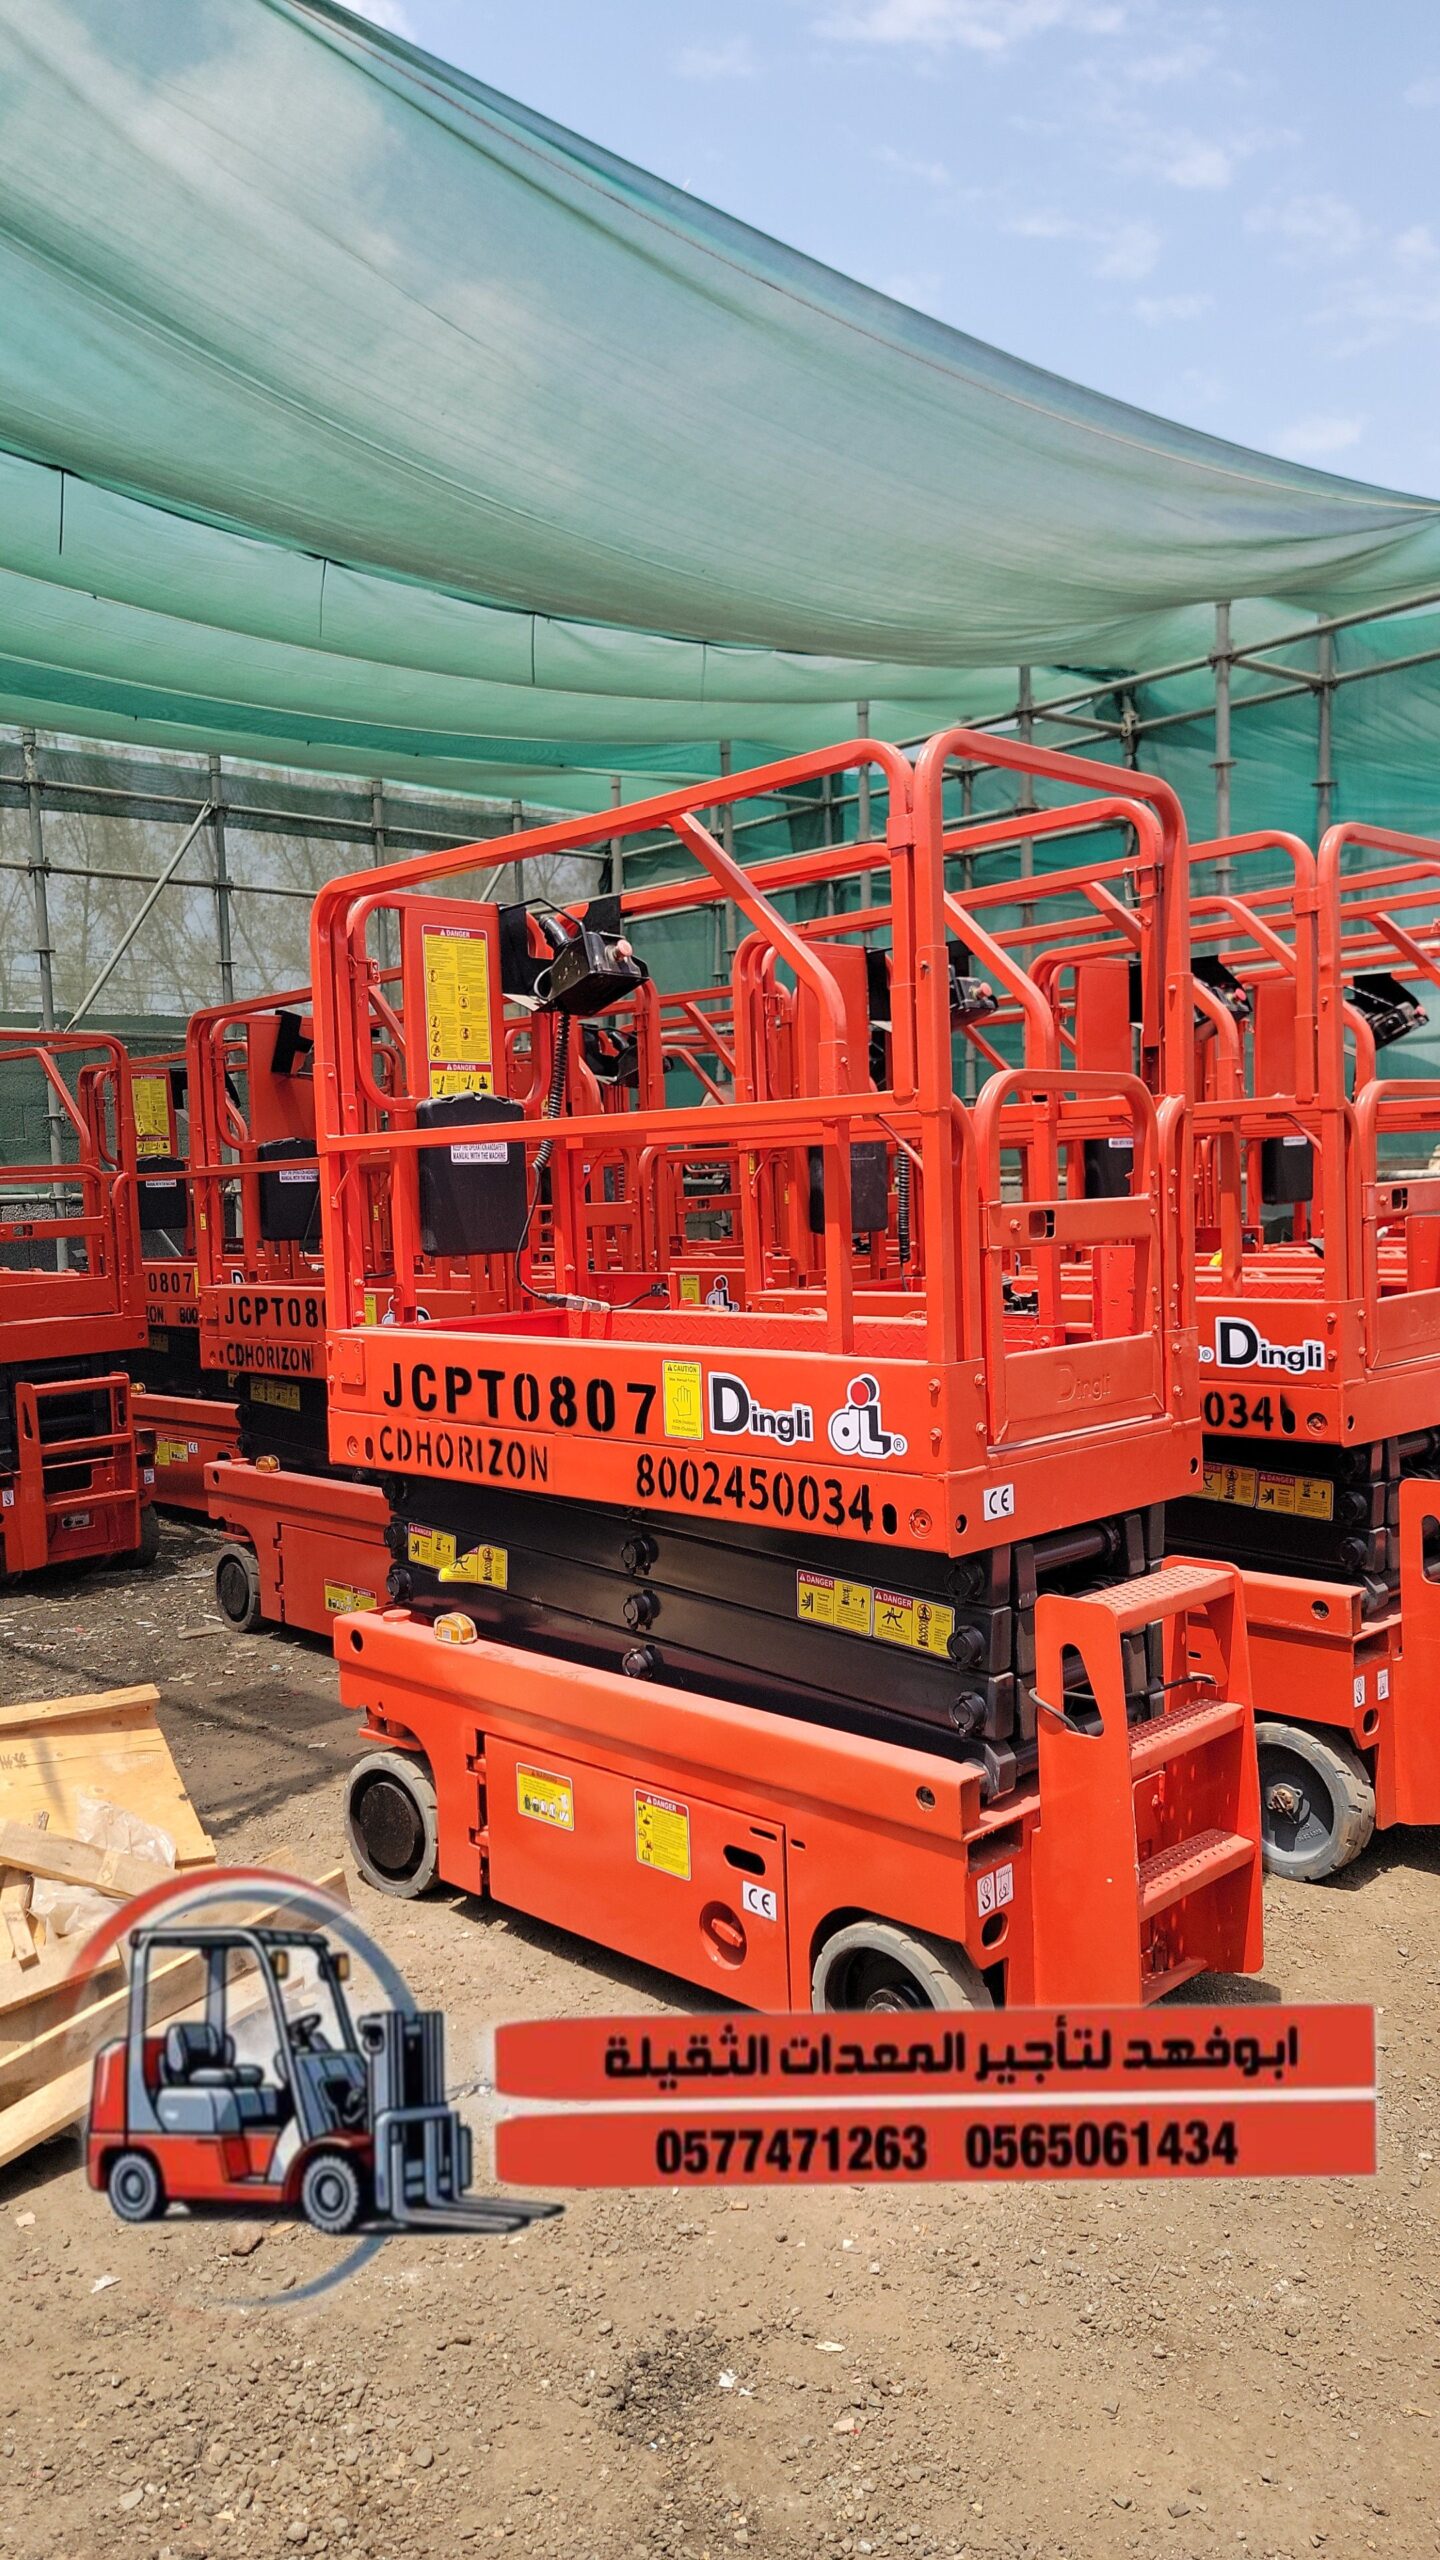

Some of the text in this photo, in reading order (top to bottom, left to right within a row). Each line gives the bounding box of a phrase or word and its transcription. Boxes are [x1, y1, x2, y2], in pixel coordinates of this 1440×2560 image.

[445, 929, 470, 938] DANGER
[452, 1064, 476, 1072] DANGER
[225, 1296, 327, 1328] JCPT08
[226, 1343, 313, 1372] CDHORIZON
[1219, 1320, 1322, 1372] Dingli
[673, 1365, 697, 1373] CAUTION
[383, 1363, 657, 1435] JCPT0807
[711, 1376, 812, 1443] Dingli
[1201, 1391, 1274, 1431] 034
[379, 1425, 548, 1482] CDHORIZON
[1267, 1474, 1295, 1485] DANGER
[636, 1453, 874, 1534] 8002450034
[989, 1488, 1009, 1514] CE
[806, 1574, 834, 1588] DANGER
[882, 1593, 912, 1608] DANGER
[652, 1797, 677, 1812] DANGER
[749, 1888, 771, 1915] CE
